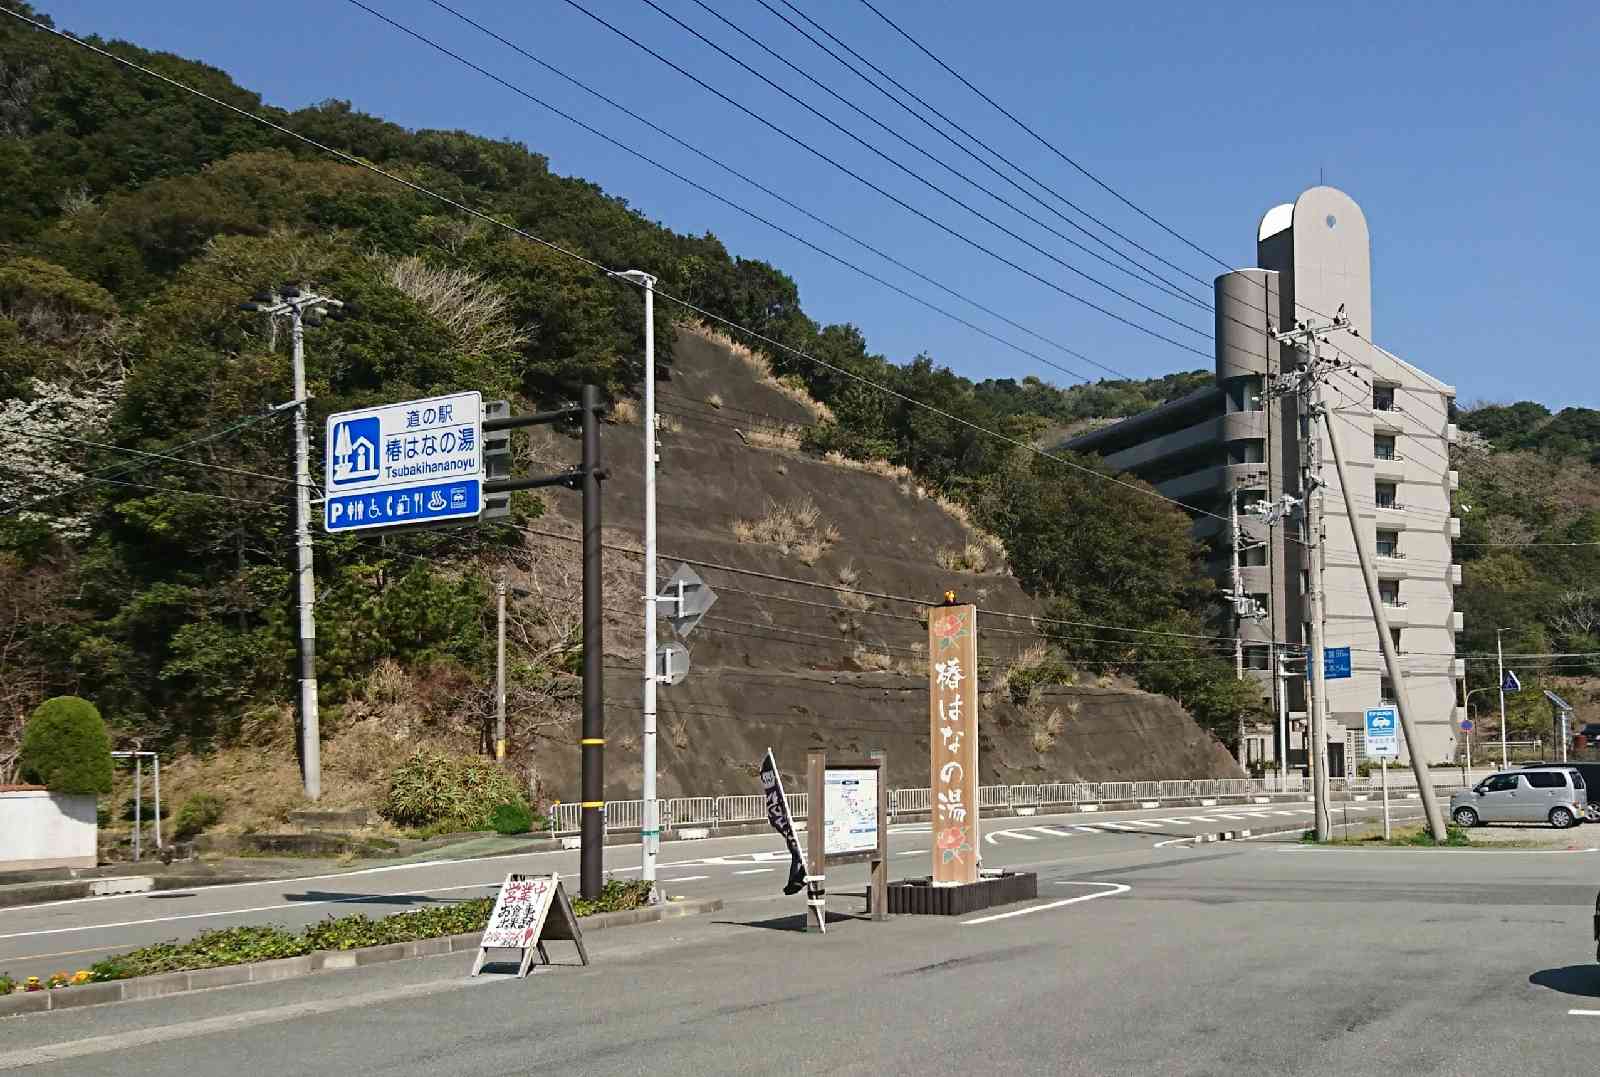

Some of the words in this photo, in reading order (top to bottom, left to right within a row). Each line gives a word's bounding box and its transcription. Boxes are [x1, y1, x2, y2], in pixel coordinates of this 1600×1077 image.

[406, 404, 453, 428] 道の駅
[385, 427, 475, 464] 椿はなの湯
[385, 457, 475, 480] Tsubakihananoyu
[935, 656, 967, 823] 椿はなの湯
[504, 881, 548, 905] 営業中
